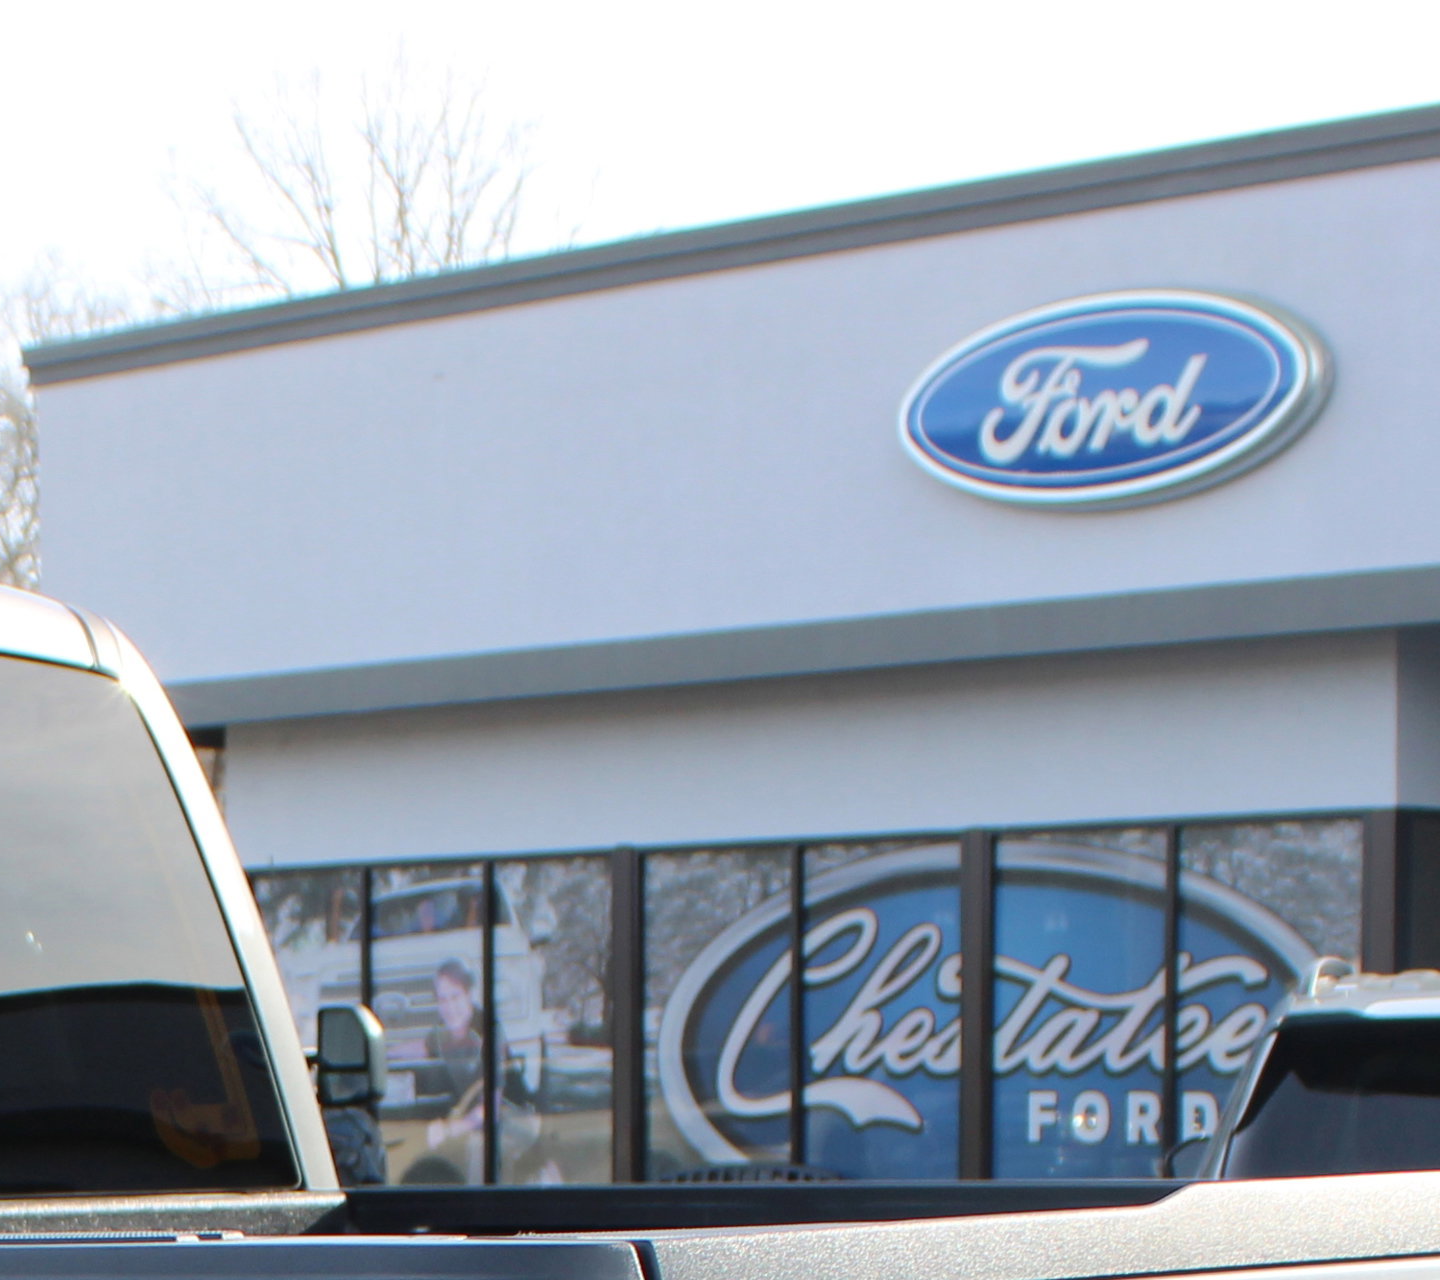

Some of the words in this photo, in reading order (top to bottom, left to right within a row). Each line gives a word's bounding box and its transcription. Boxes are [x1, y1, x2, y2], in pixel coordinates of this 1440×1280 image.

[978, 337, 1208, 465] Ford
[717, 906, 1269, 1131] Chestatee
[1026, 1089, 1220, 1145] FORD
